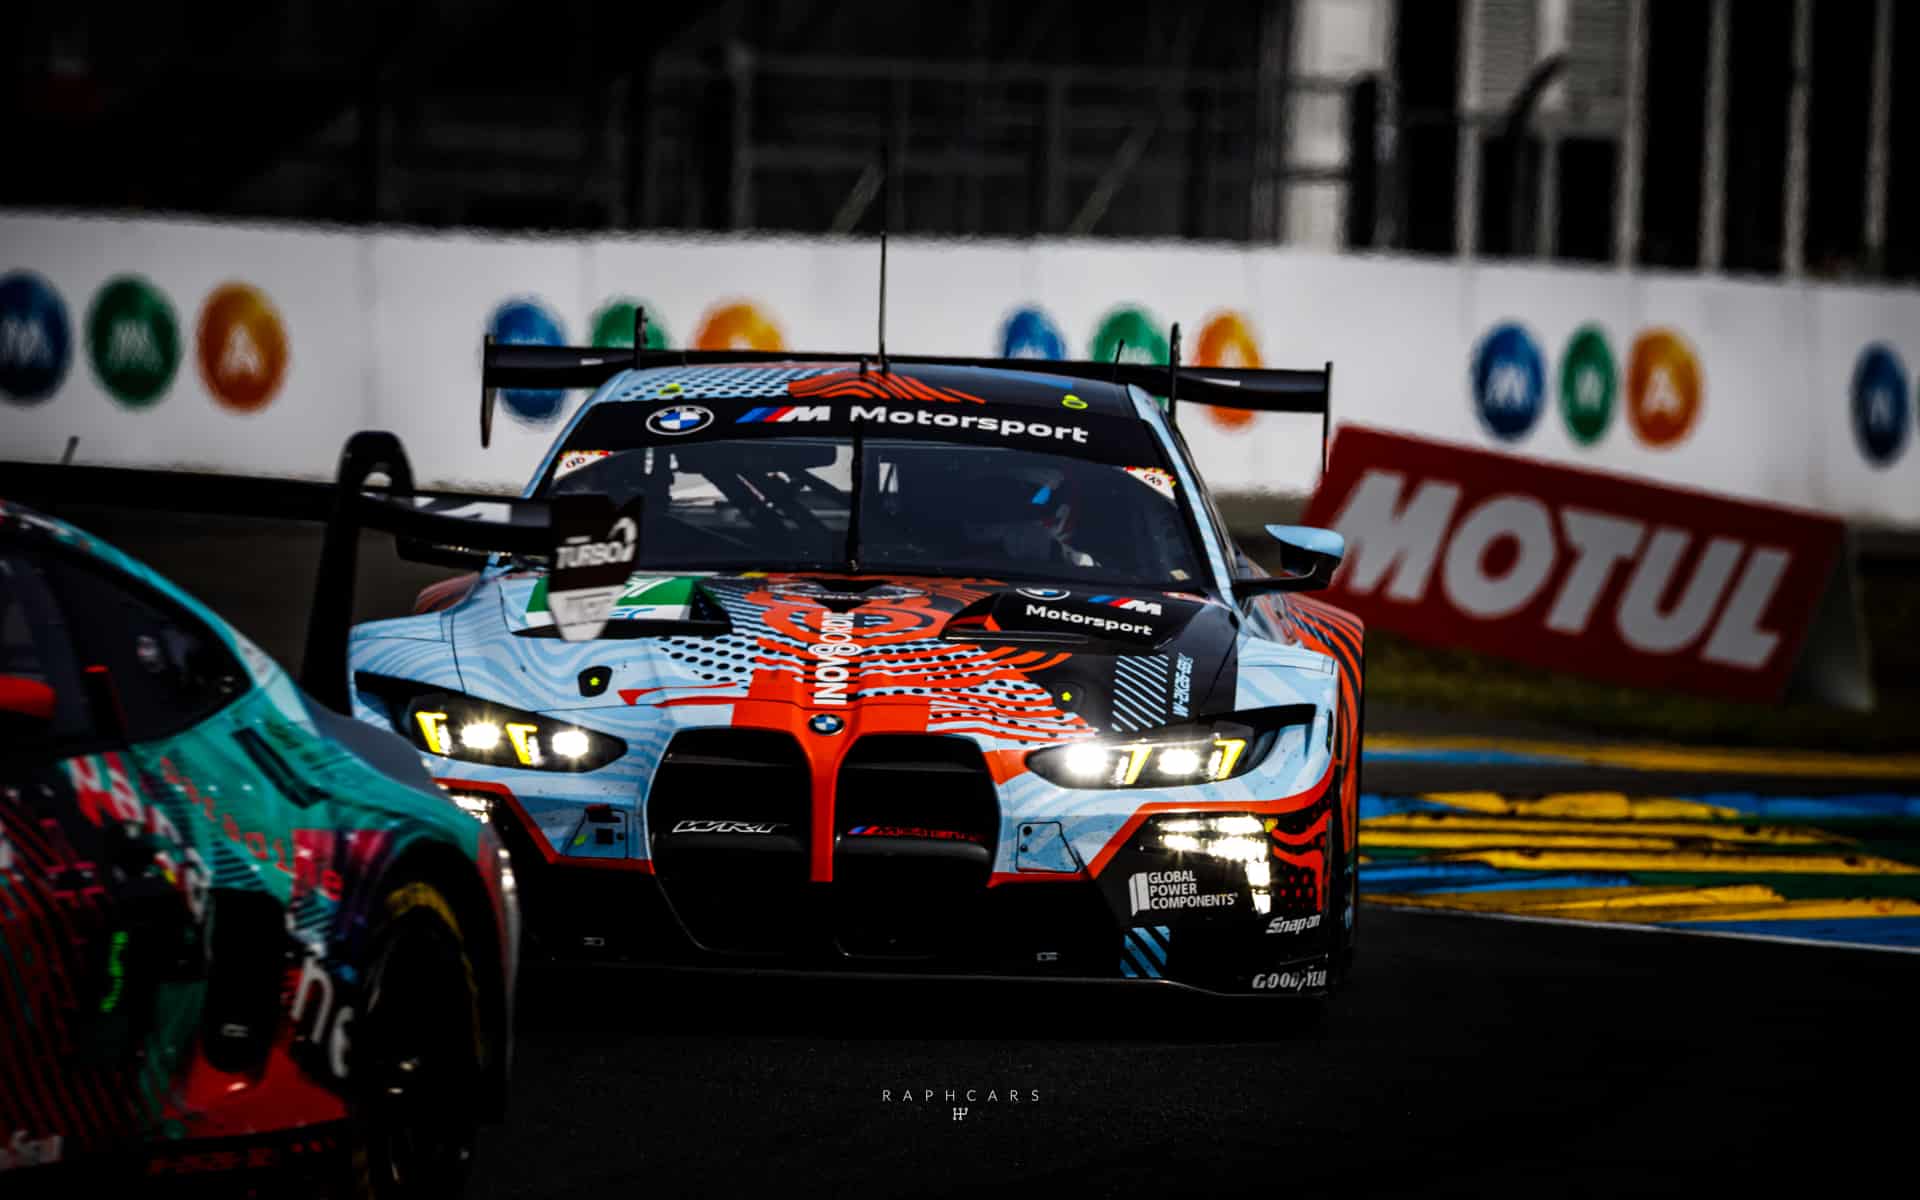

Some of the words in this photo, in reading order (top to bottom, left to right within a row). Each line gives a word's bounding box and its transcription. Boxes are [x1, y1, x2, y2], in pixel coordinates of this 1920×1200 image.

[850, 405, 1089, 444] Motorsport
[1331, 468, 1791, 669] MOTUL
[1026, 603, 1153, 636] Motorsport
[1149, 870, 1197, 884] GLOBAL
[1150, 884, 1198, 897] POWER
